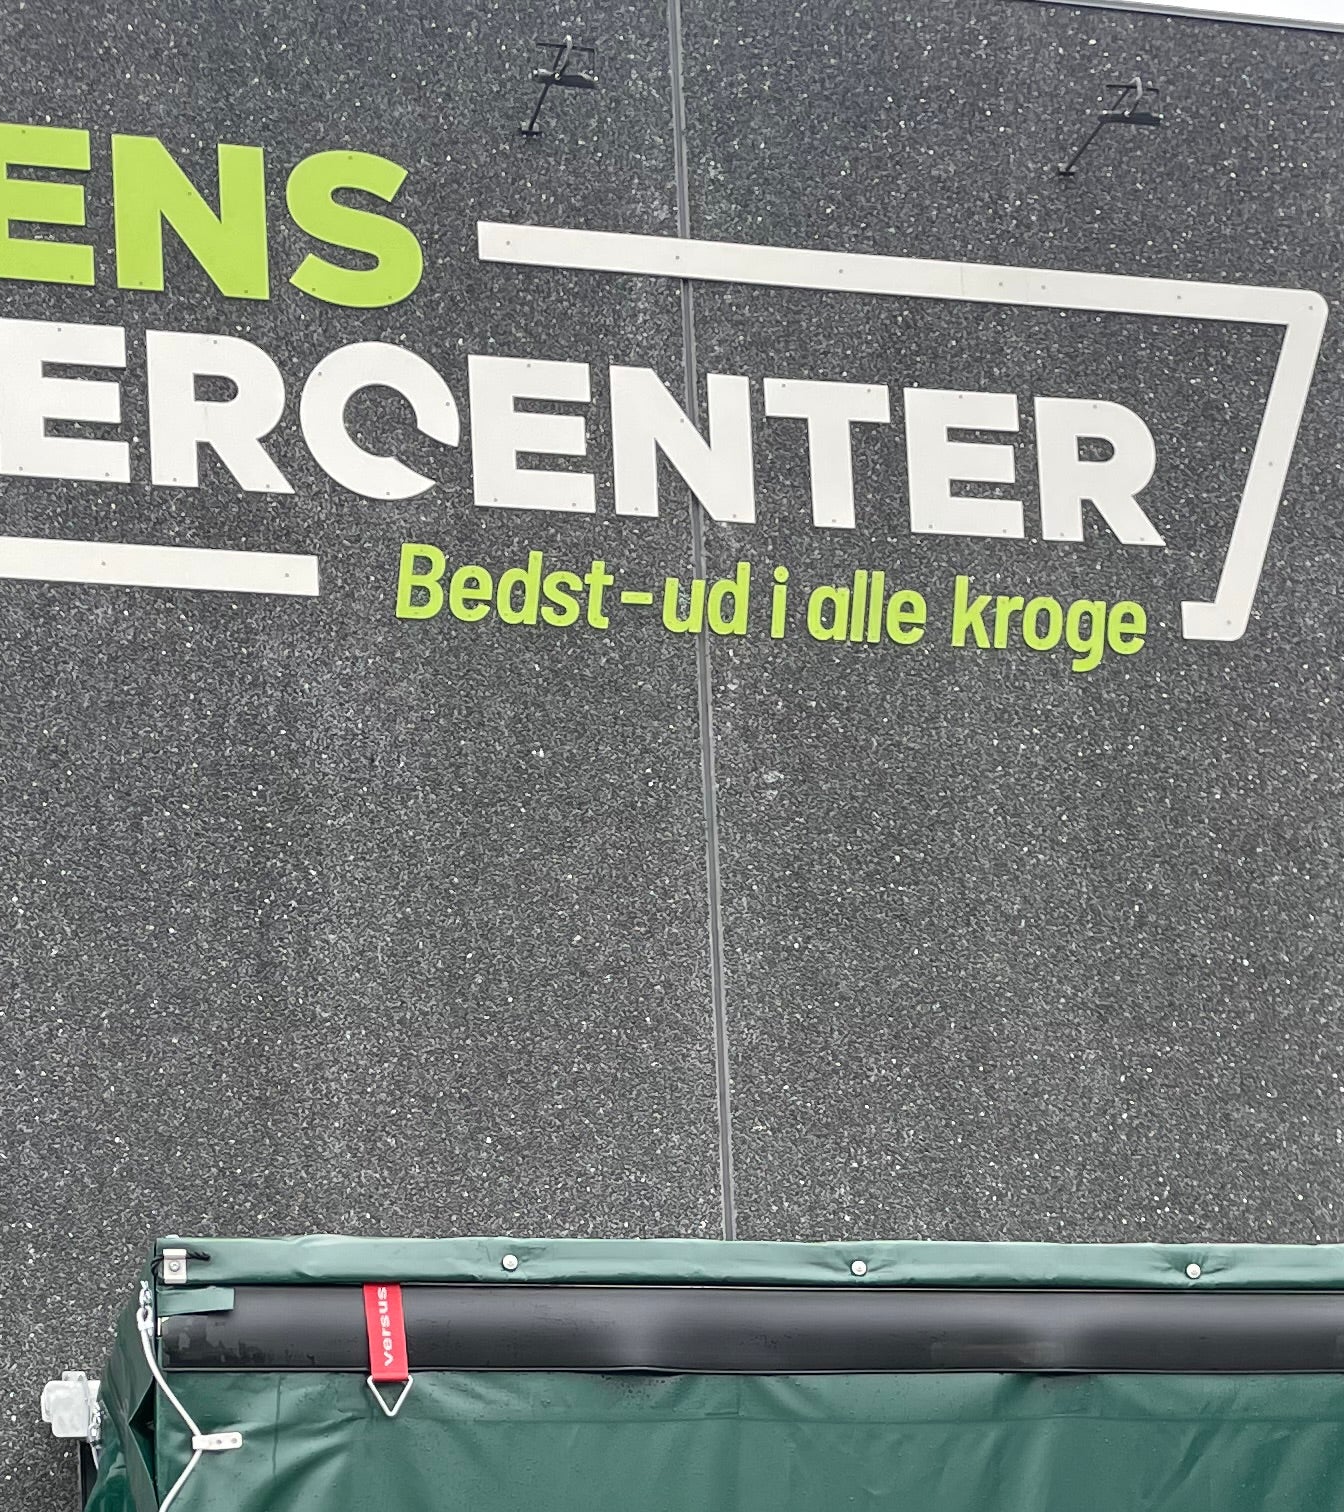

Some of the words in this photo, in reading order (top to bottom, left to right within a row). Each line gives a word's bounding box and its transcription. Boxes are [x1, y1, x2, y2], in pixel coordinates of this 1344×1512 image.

[396, 542, 751, 635] Bedst-ud
[770, 565, 789, 638] i
[806, 570, 928, 644] alle
[951, 575, 1147, 673] kroge
[377, 1286, 394, 1367] versus
